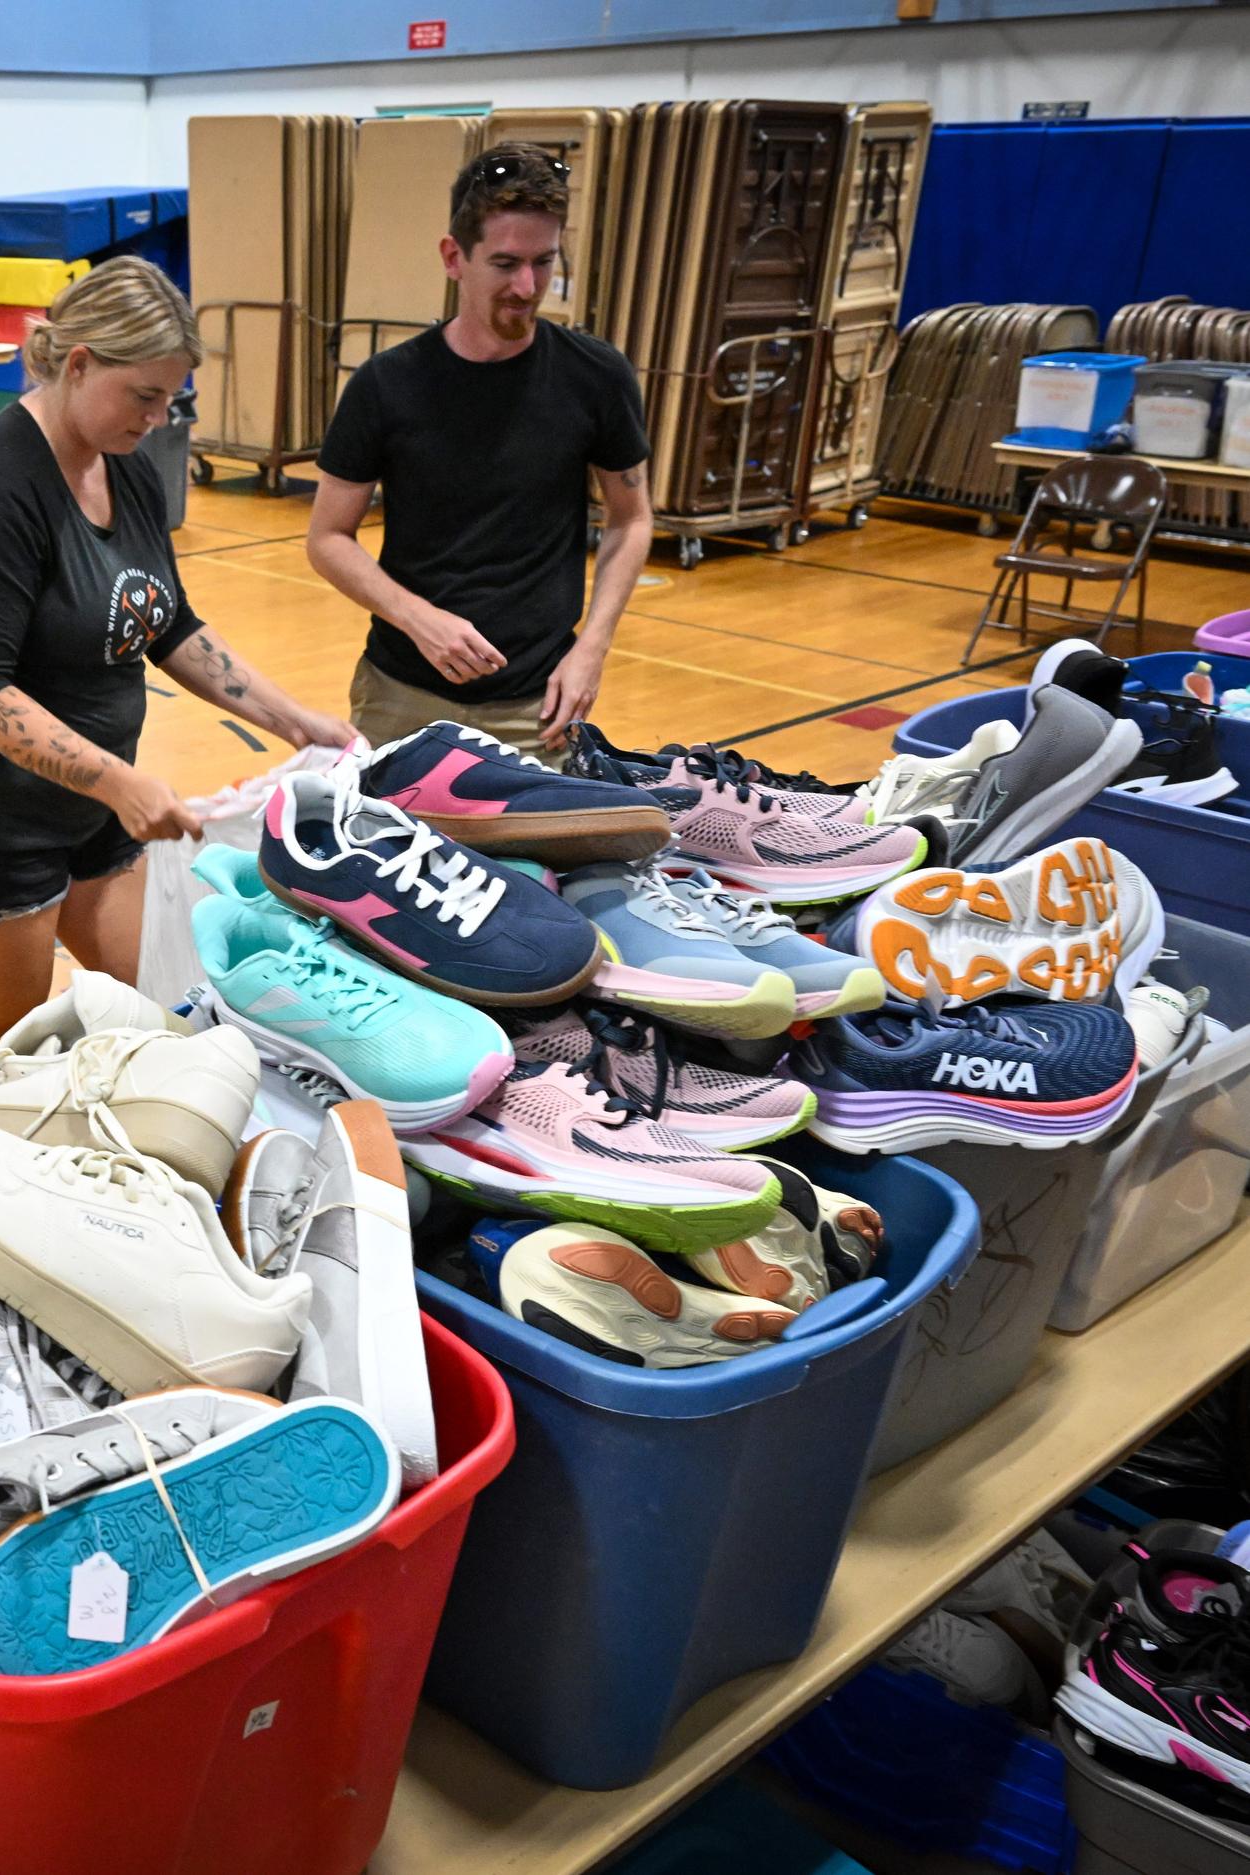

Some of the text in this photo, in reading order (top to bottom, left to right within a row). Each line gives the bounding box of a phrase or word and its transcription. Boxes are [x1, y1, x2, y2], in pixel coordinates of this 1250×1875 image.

[127, 568, 147, 579] REAL
[931, 1052, 1038, 1095] HOKA
[83, 1214, 144, 1240] NAUTICA
